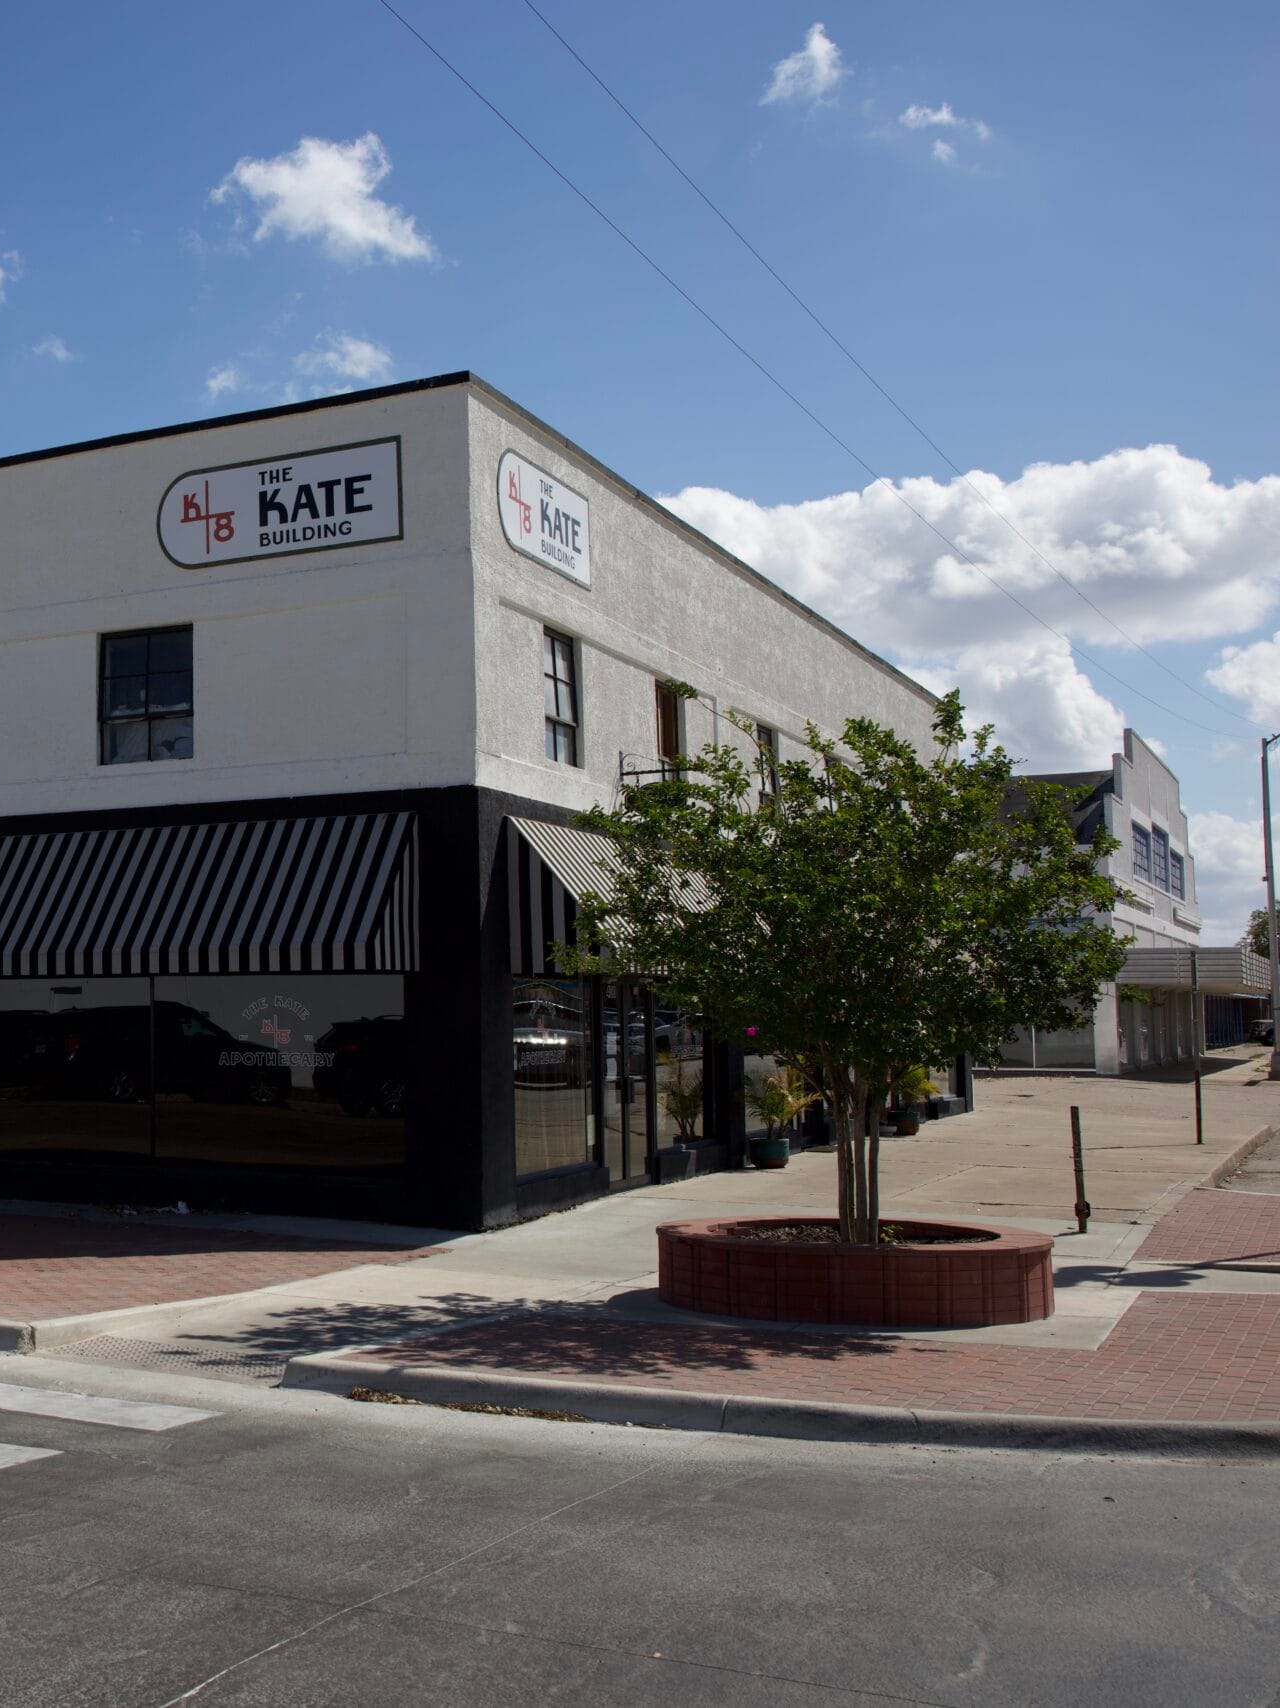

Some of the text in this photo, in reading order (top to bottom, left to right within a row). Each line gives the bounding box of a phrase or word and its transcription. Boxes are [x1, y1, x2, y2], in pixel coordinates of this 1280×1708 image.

[259, 467, 293, 486] THE
[539, 479, 554, 499] THE
[258, 474, 373, 527] KATE
[259, 521, 352, 547] BUILDING
[540, 498, 582, 555] KATE
[541, 539, 576, 570] BUILDING
[242, 995, 311, 1021] THE KATE
[218, 1052, 335, 1067] APOTHECARY
